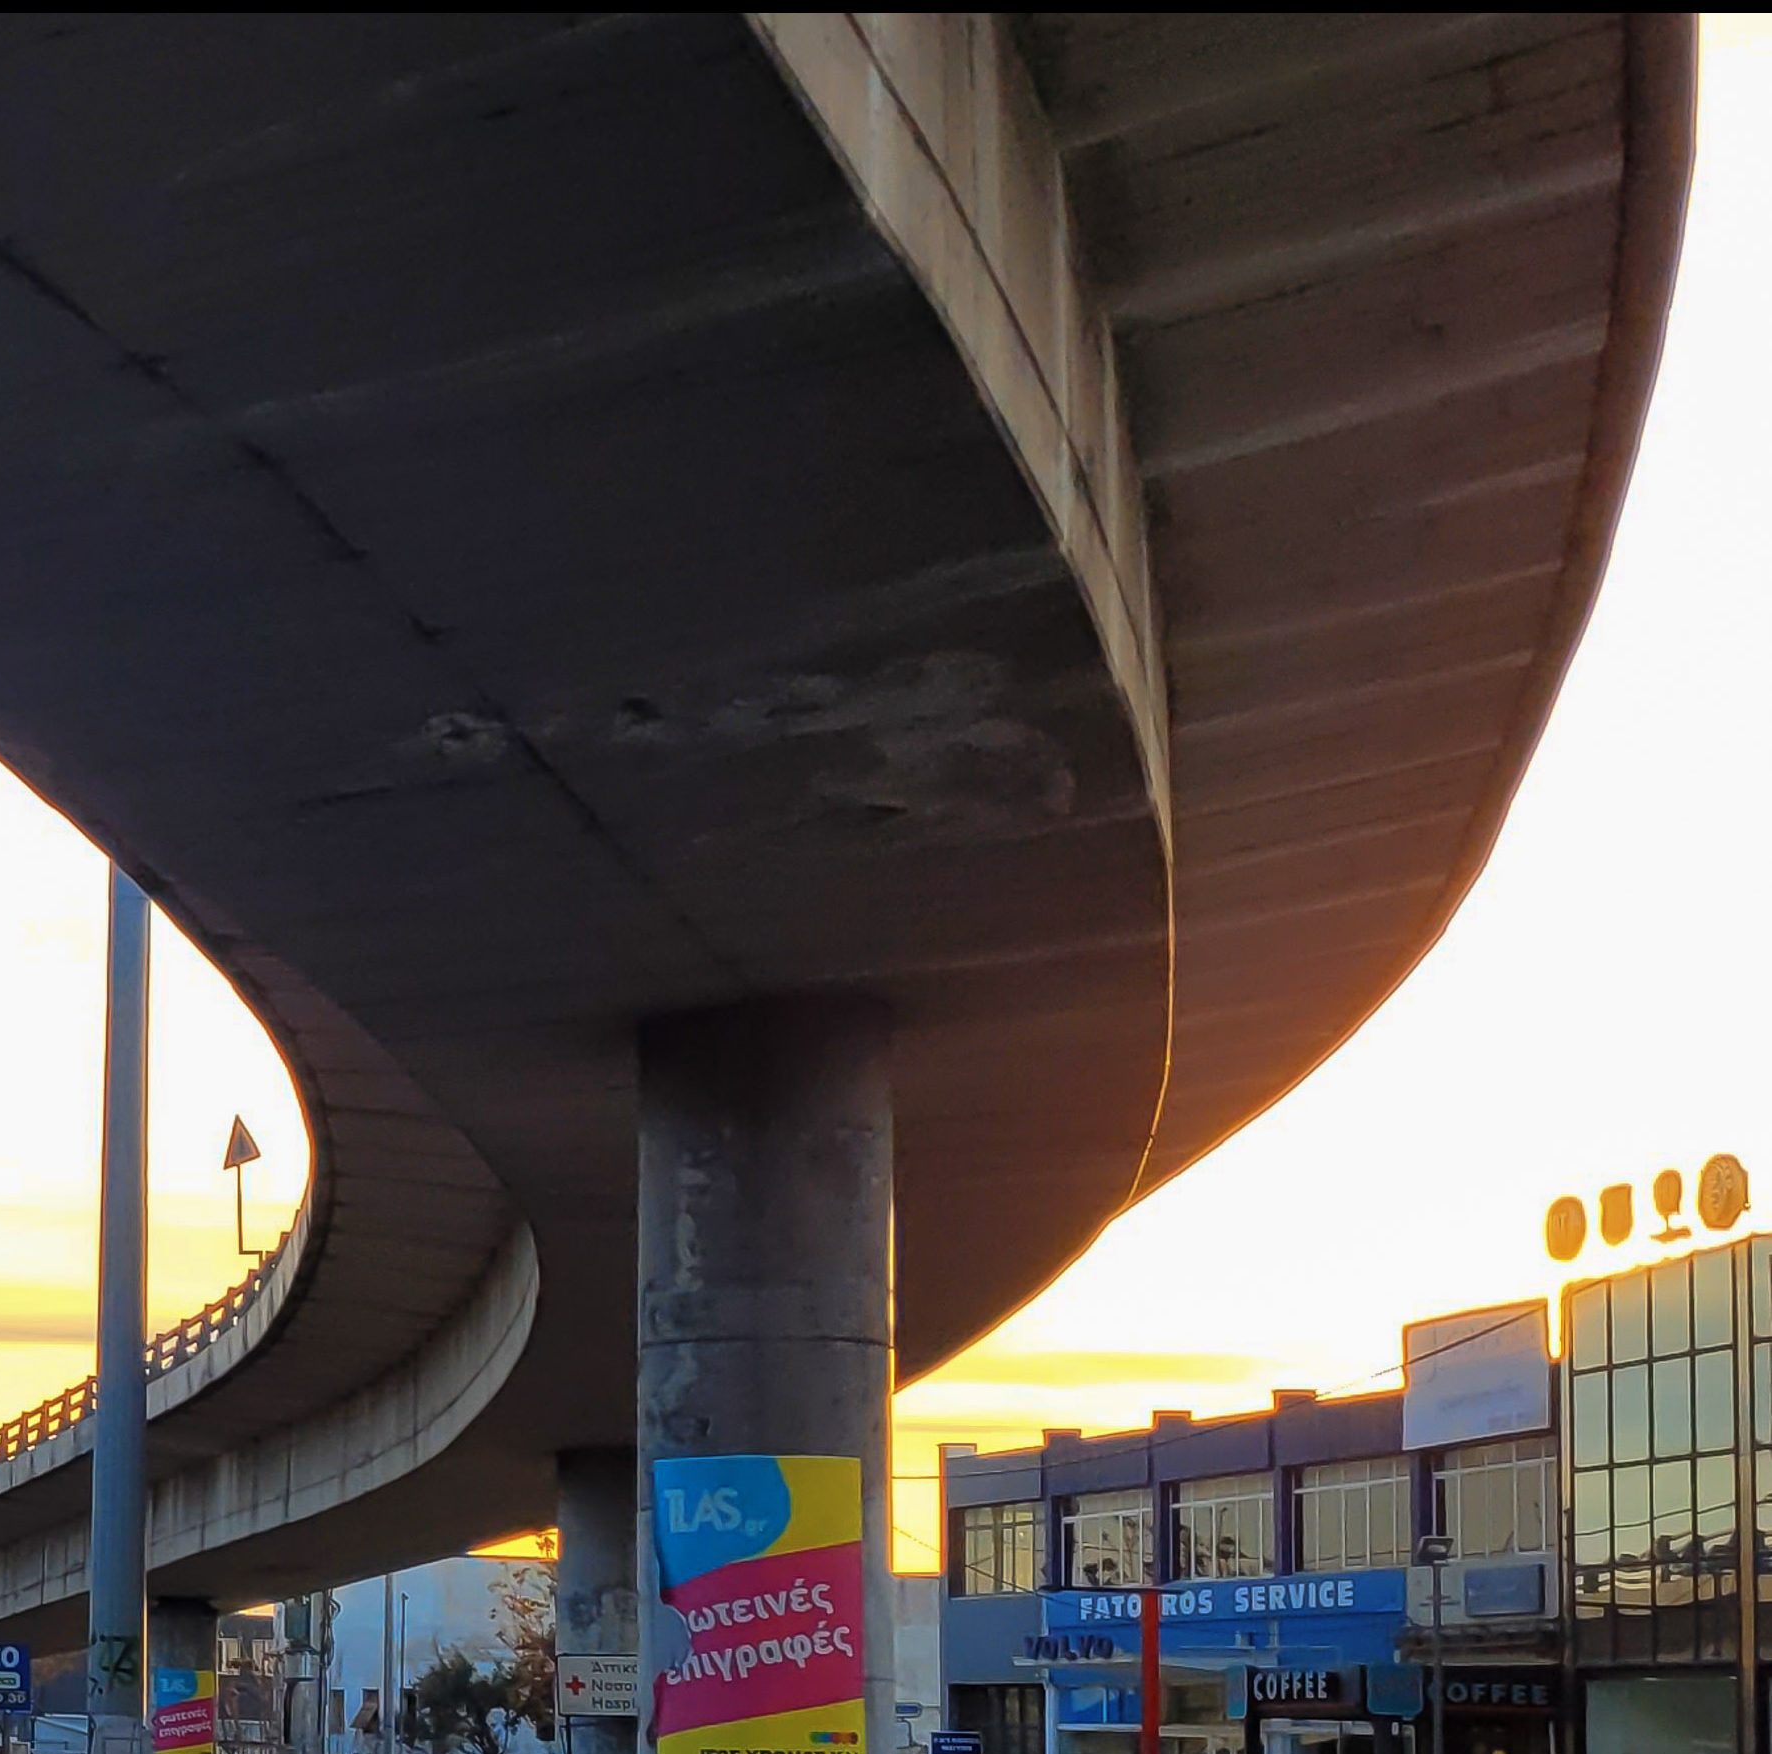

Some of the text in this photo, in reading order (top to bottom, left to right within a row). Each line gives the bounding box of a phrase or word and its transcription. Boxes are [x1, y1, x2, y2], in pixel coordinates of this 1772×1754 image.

[686, 1578, 834, 1634] ωτεινές
[1080, 1579, 1355, 1621] FATOROS SERVICE
[1254, 1671, 1328, 1700] COFFEE
